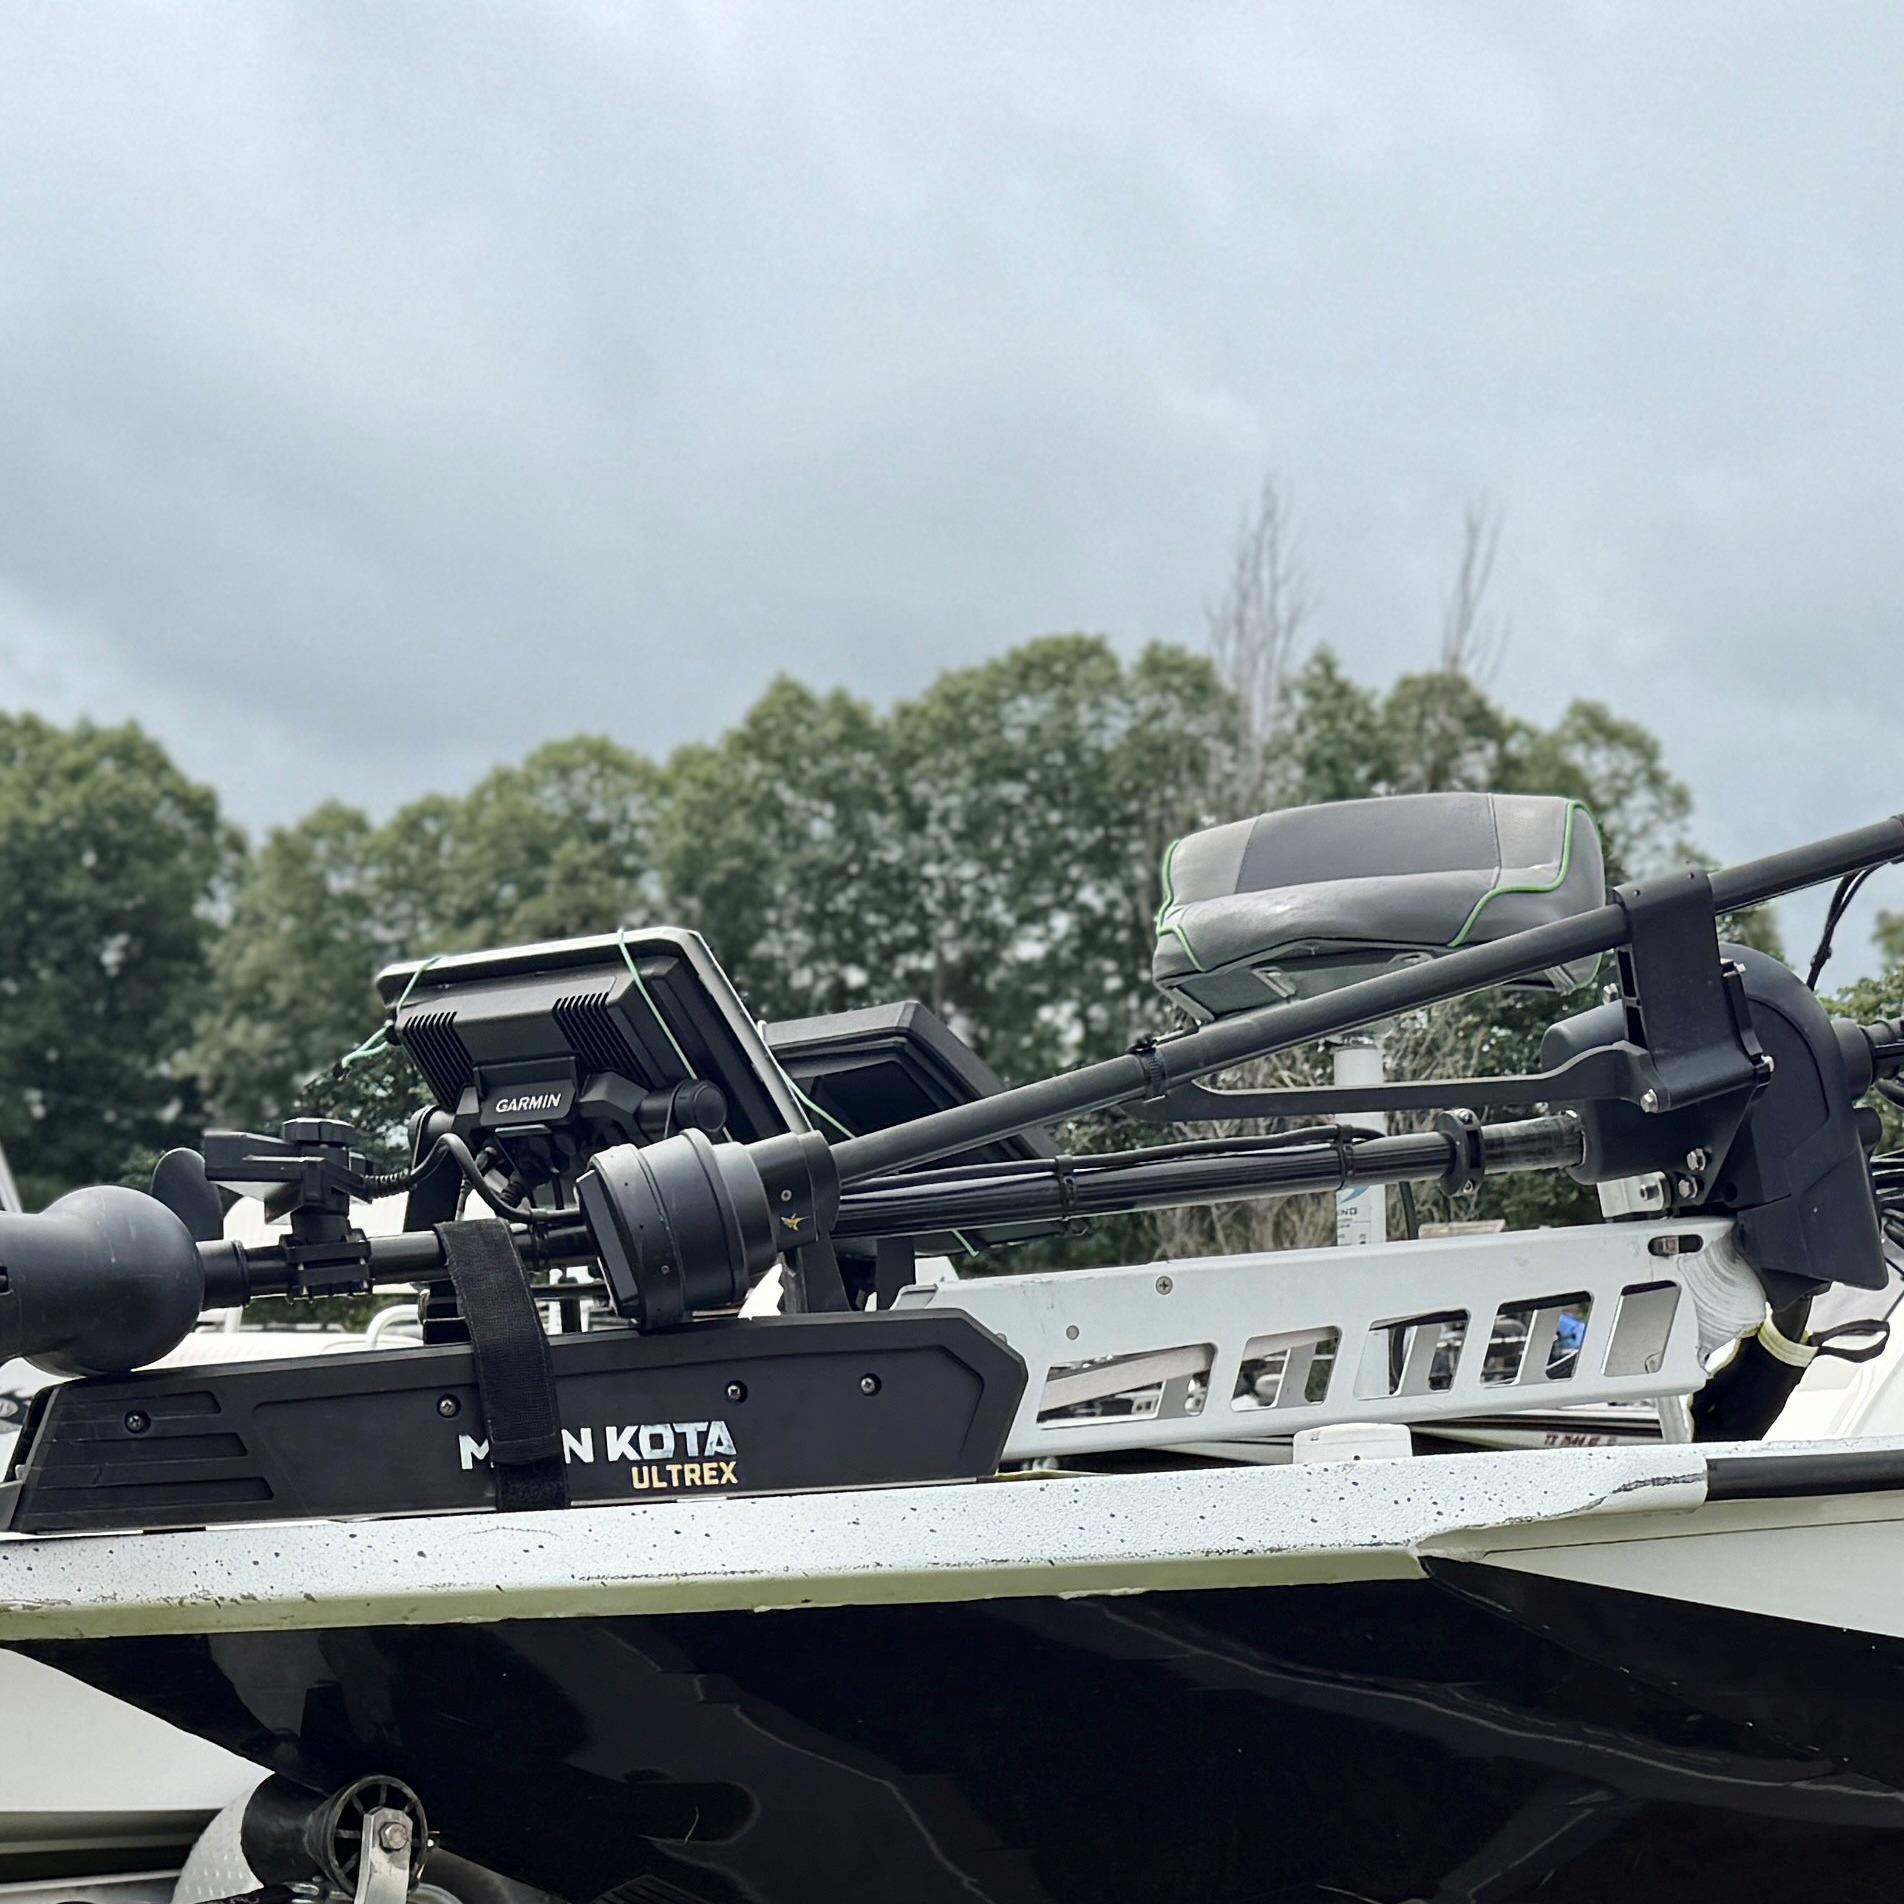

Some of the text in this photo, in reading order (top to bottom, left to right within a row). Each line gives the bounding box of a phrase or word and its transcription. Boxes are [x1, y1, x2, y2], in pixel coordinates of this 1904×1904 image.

[496, 1093, 561, 1112] GARMIN
[458, 1420, 737, 1470] MN KOTA
[631, 1461, 738, 1490] ULTREX
